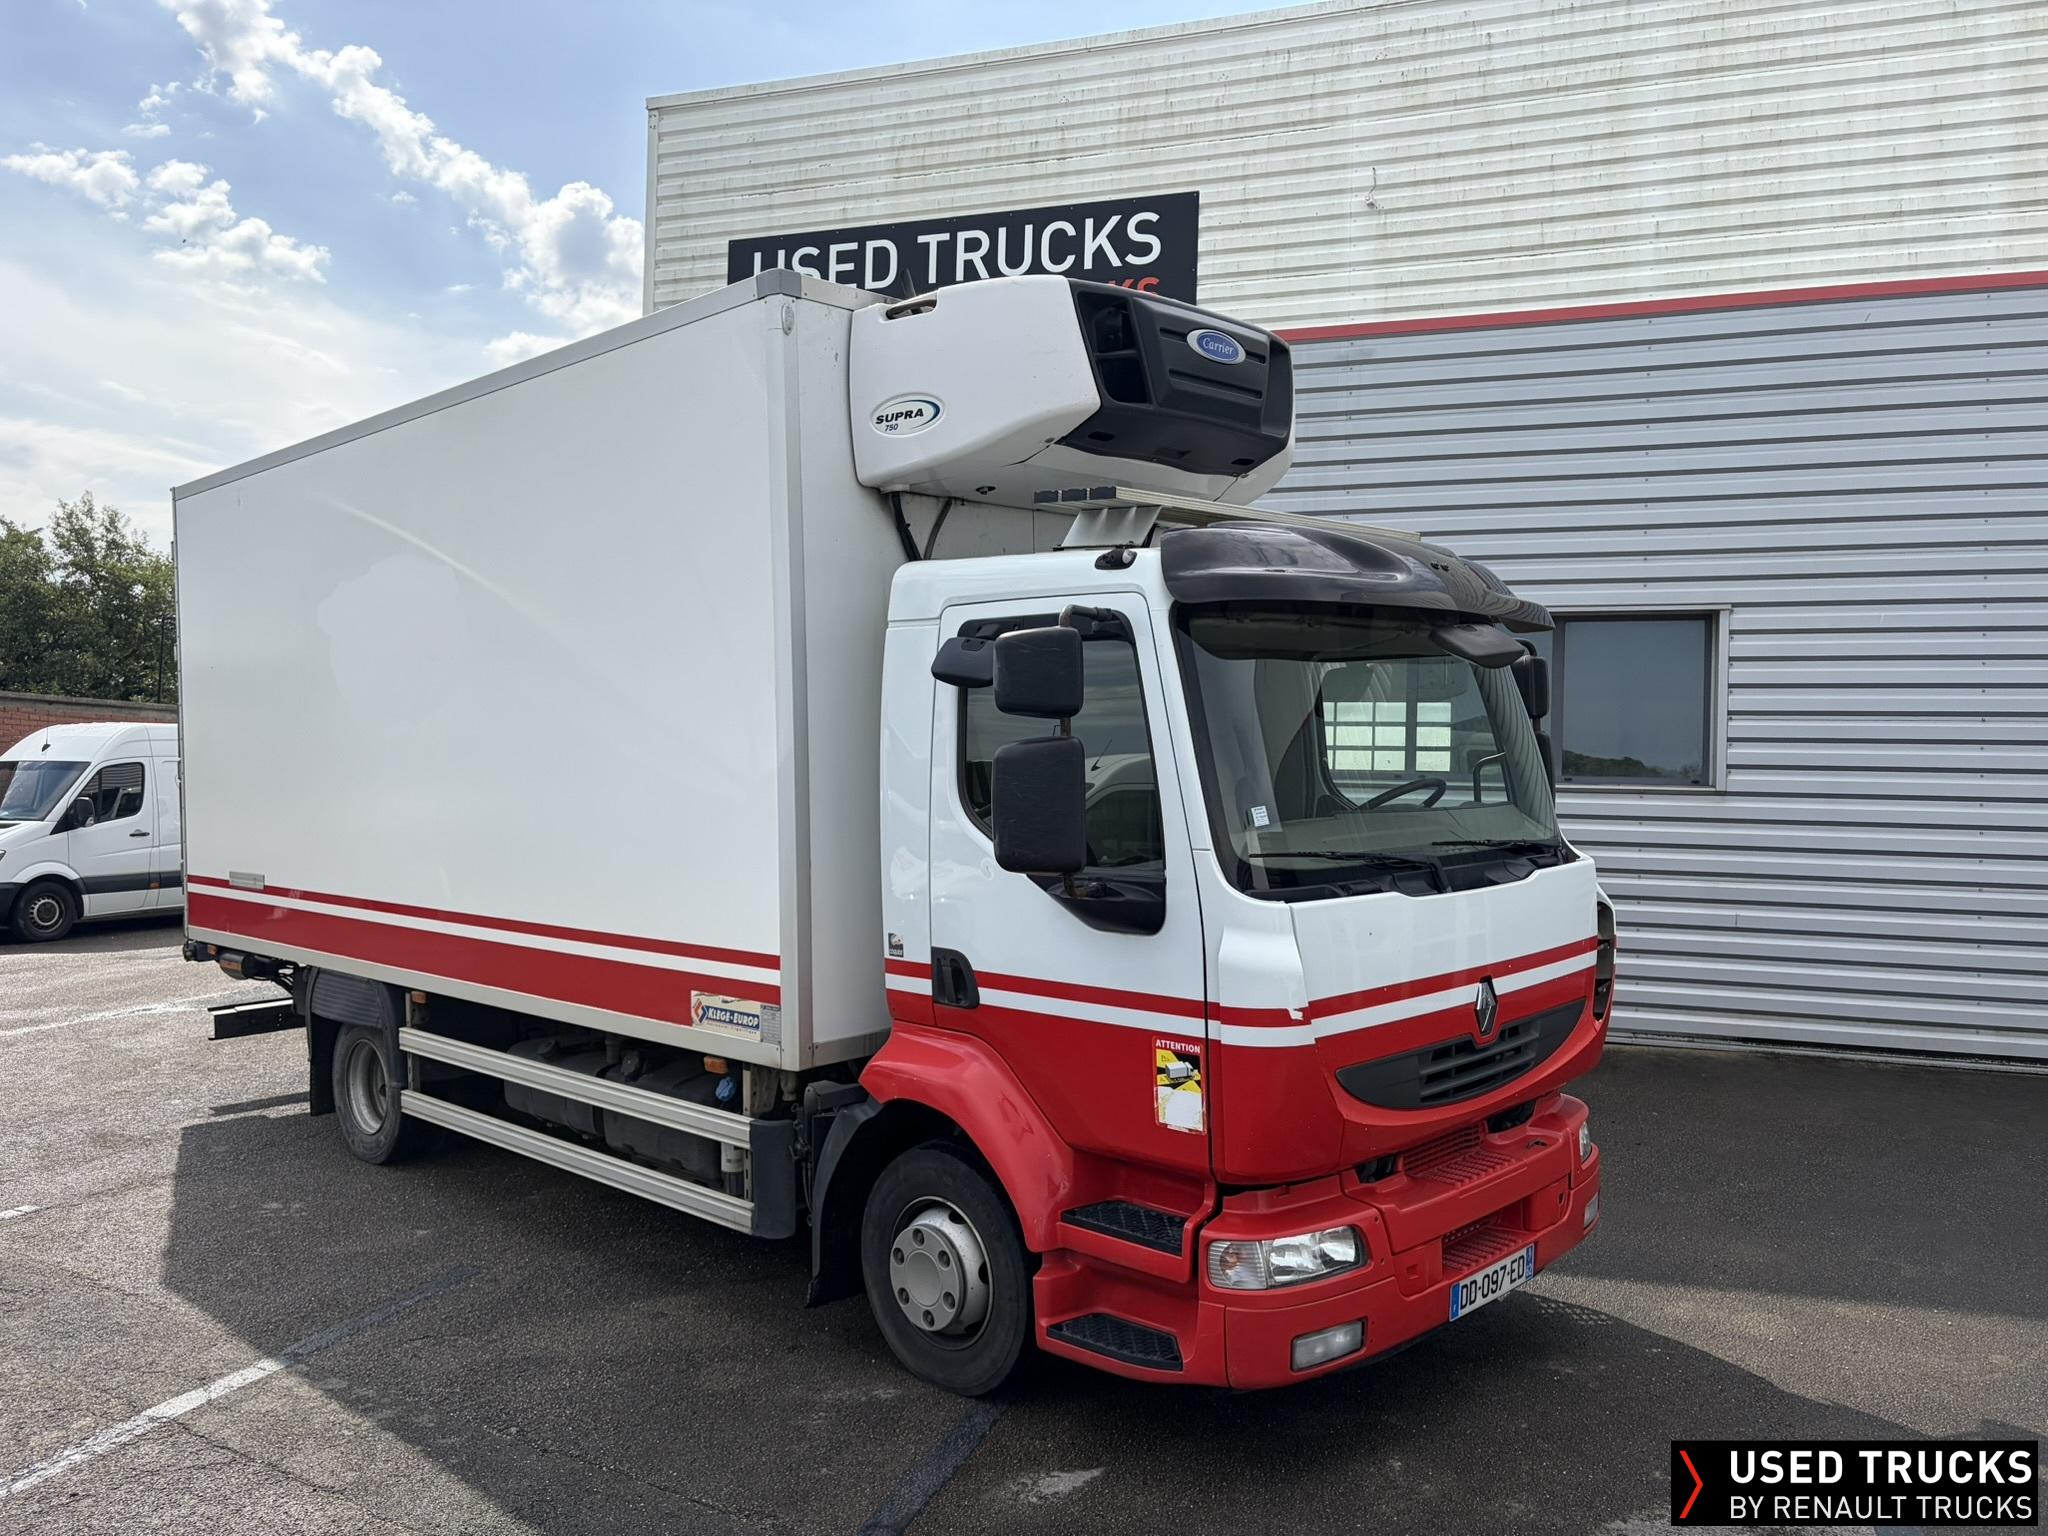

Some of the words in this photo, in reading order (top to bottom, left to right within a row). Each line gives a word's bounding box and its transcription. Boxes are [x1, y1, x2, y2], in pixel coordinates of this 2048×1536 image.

[917, 212, 1161, 283] TRUCKS
[1203, 338, 1234, 355] Carrier
[876, 408, 924, 424] SUPRA
[885, 423, 898, 431] 750
[1156, 1039, 1200, 1053] ATTENTION
[1460, 1255, 1524, 1309] DD-097-ED
